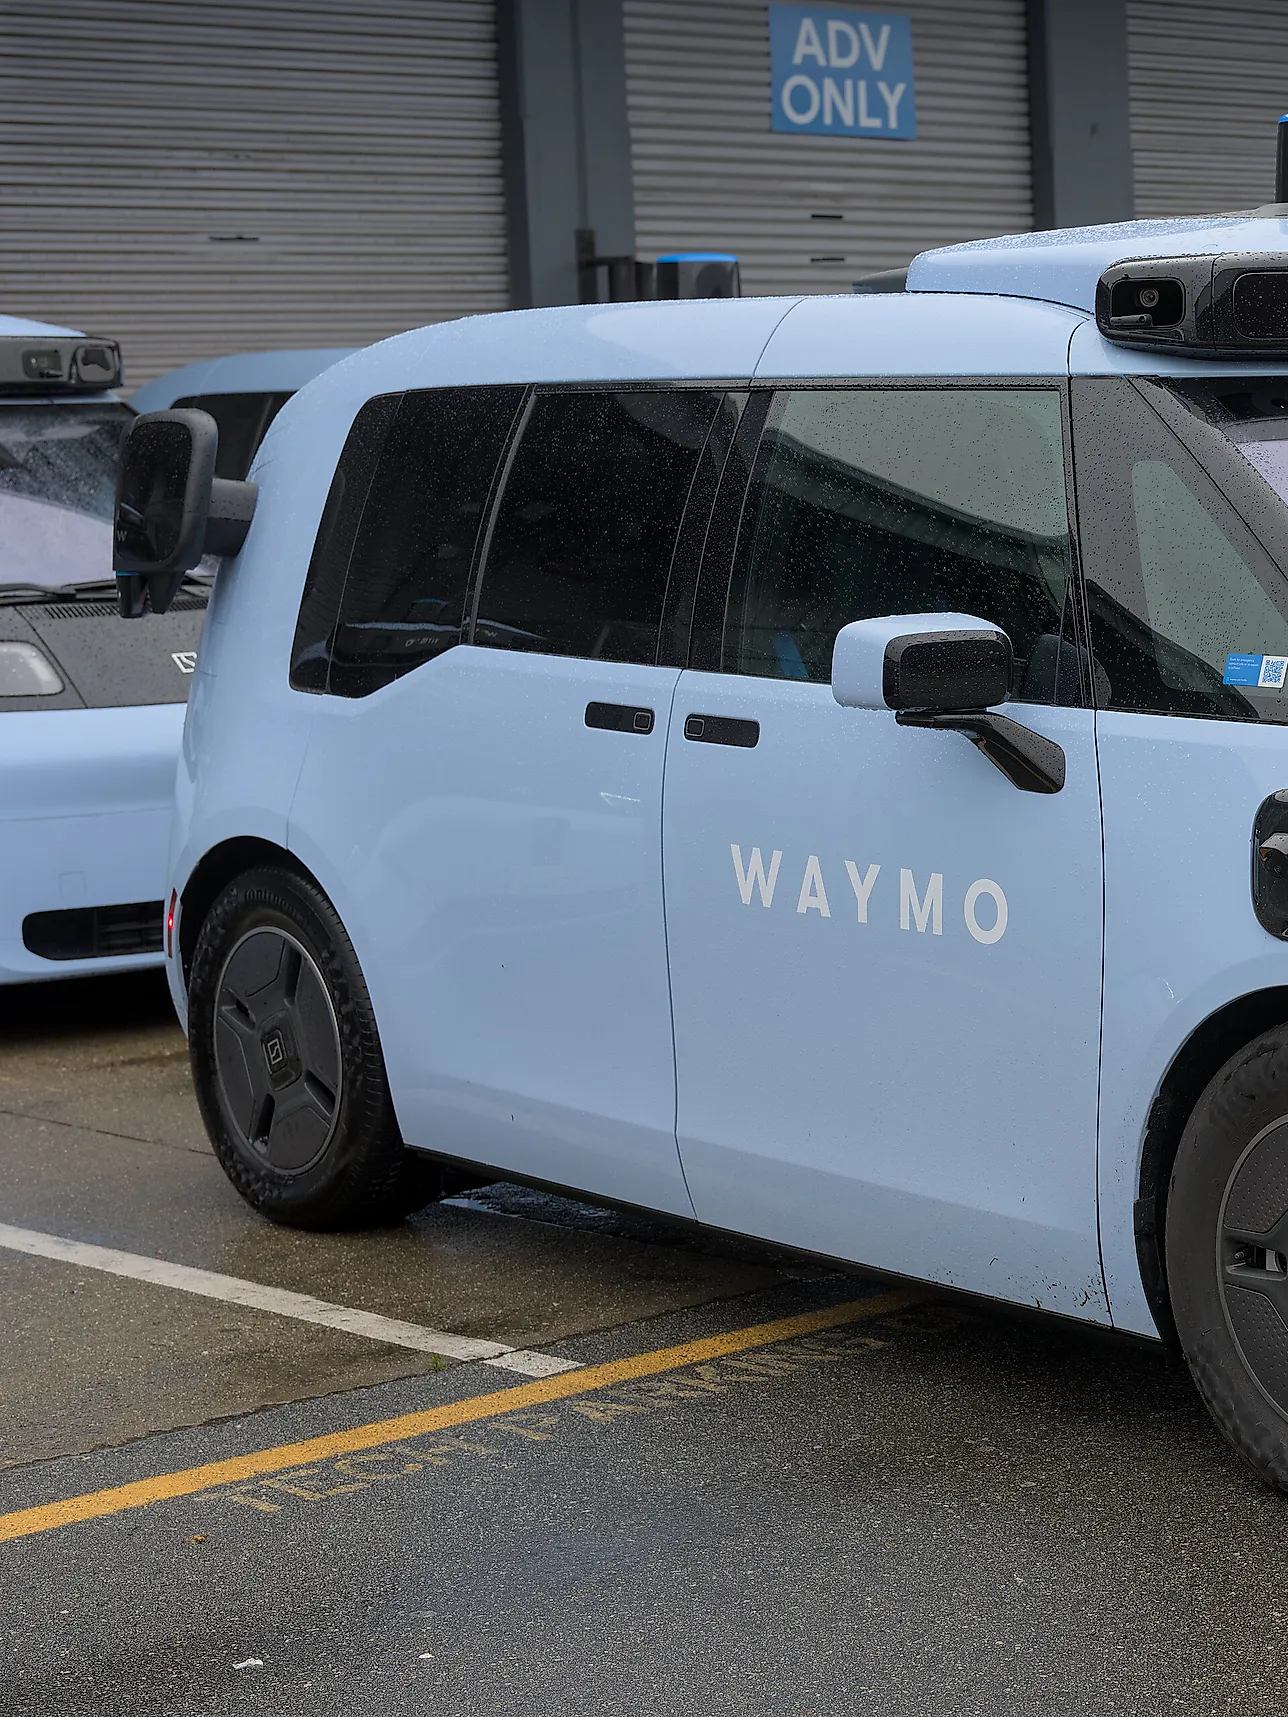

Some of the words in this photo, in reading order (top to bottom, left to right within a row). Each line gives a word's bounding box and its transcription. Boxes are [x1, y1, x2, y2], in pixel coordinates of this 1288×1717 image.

[792, 17, 891, 71] ADV
[781, 74, 907, 129] ONLY
[730, 843, 1009, 945] WAYMO
